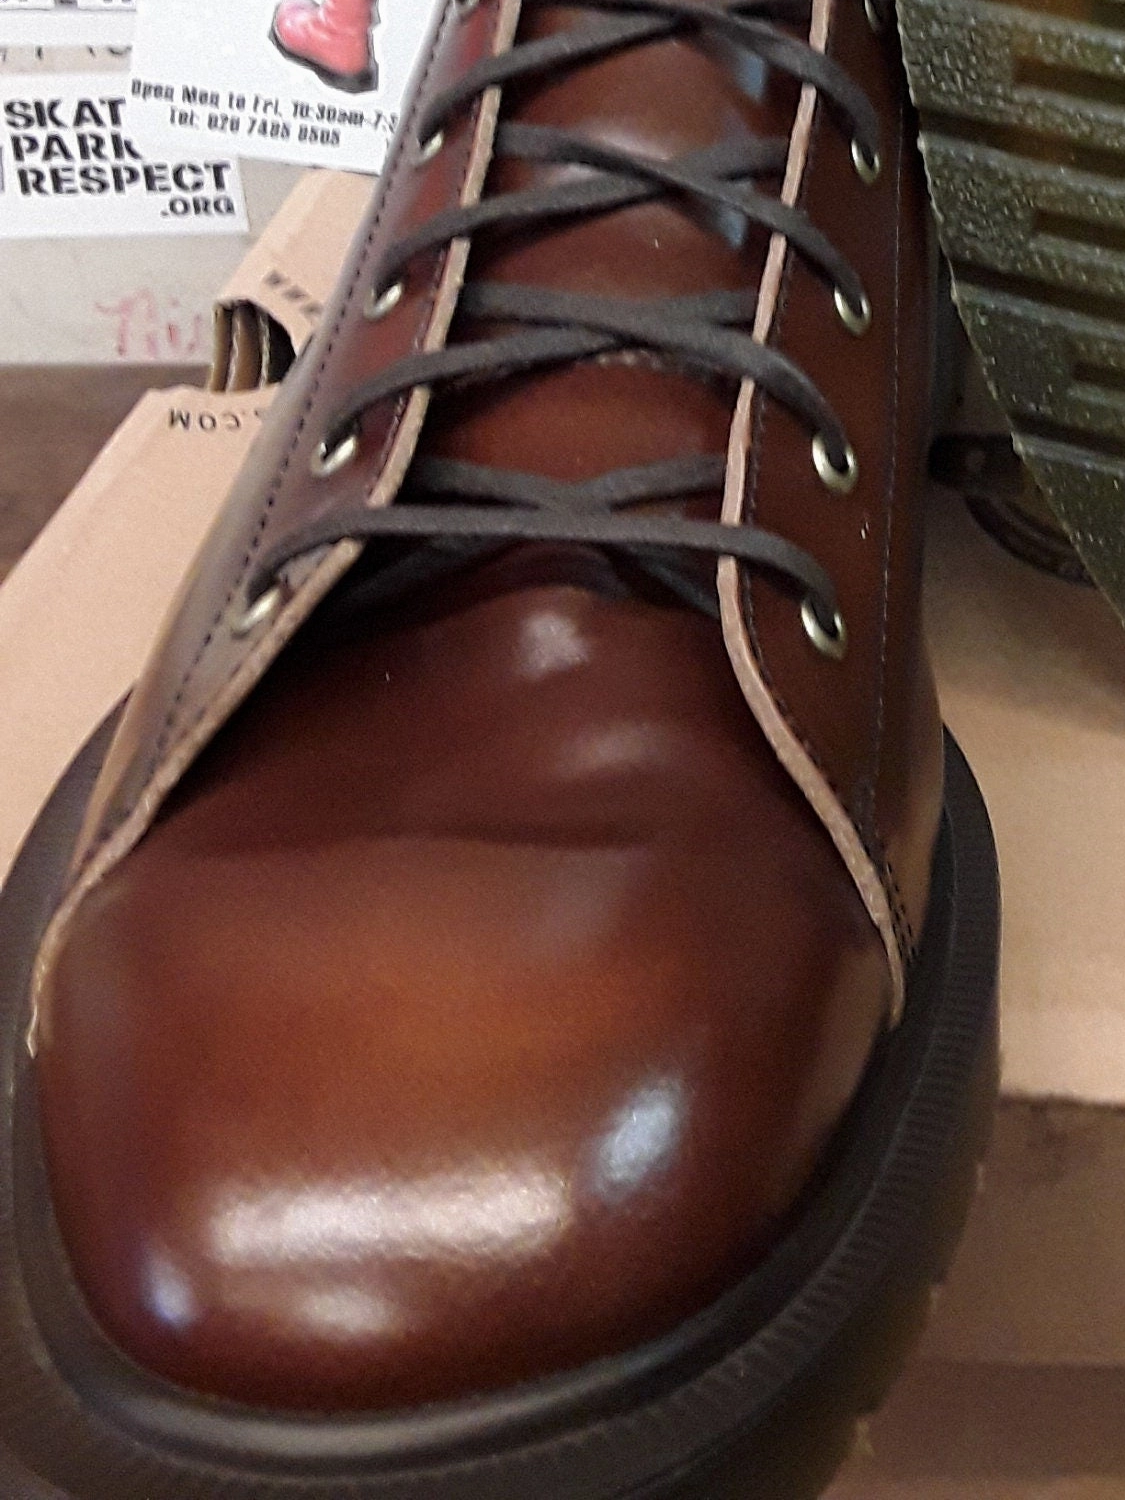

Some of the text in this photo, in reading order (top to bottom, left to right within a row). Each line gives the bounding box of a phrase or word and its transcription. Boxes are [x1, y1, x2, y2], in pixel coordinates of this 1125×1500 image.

[131, 78, 175, 100] Open
[182, 85, 221, 109] Mon
[228, 91, 247, 112] to
[3, 97, 127, 129] SKAT
[10, 133, 143, 162] PARK
[17, 161, 232, 196] RESPECT
